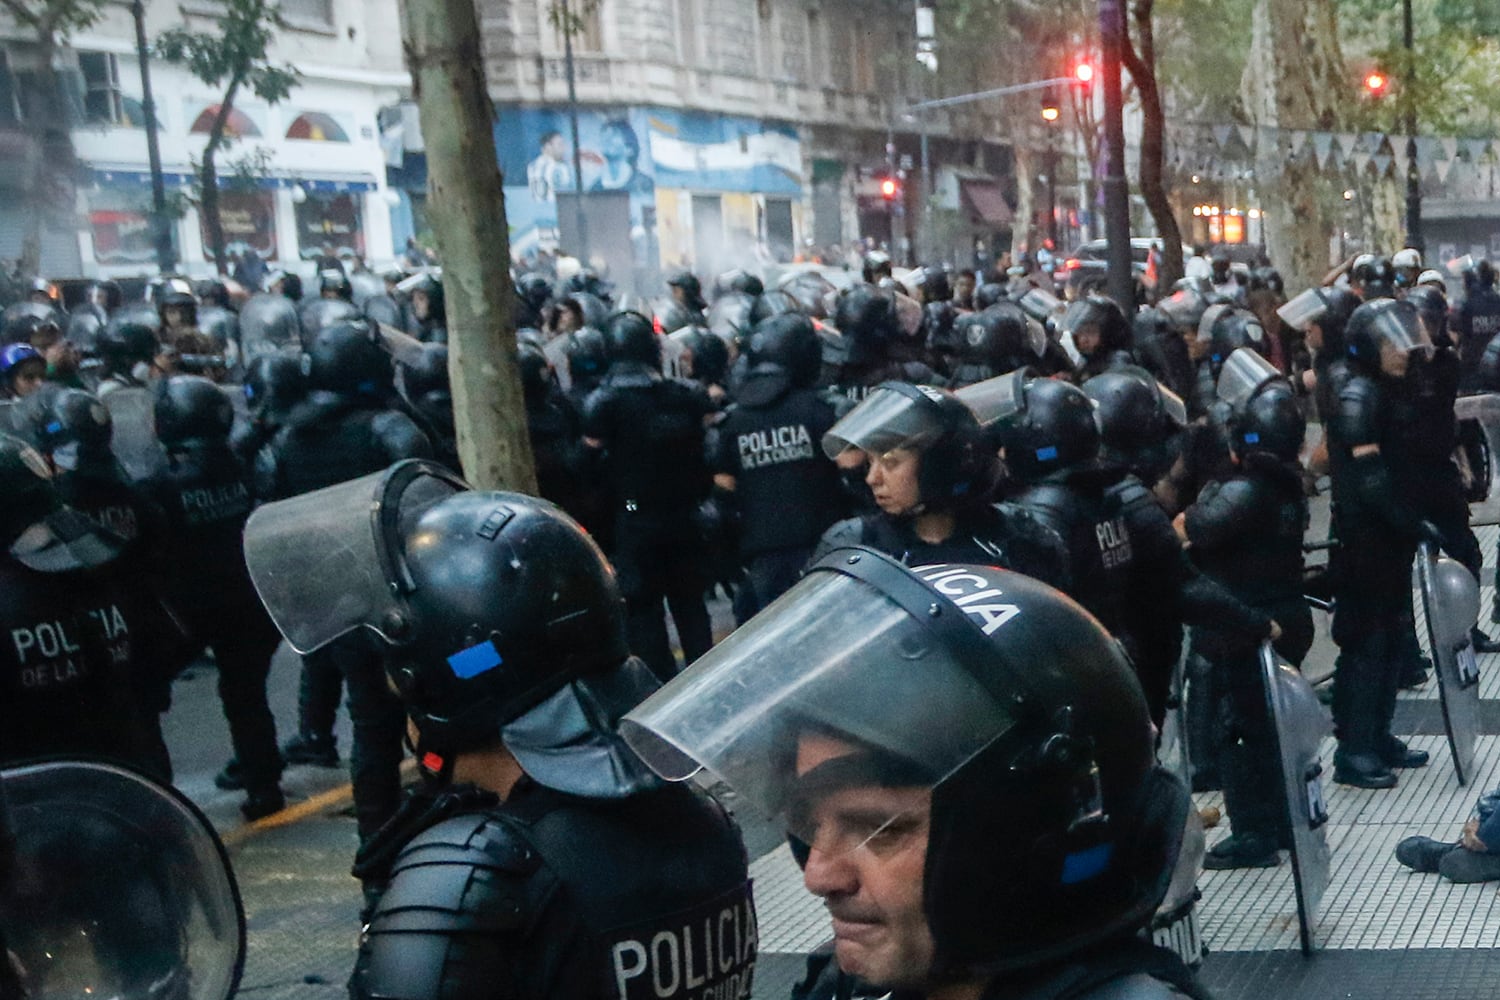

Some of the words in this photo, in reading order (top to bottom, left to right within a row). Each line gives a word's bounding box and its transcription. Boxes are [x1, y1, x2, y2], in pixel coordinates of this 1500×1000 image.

[738, 424, 811, 456] POLICIA
[910, 564, 1021, 636] ICIA
[10, 604, 128, 663] POLIA
